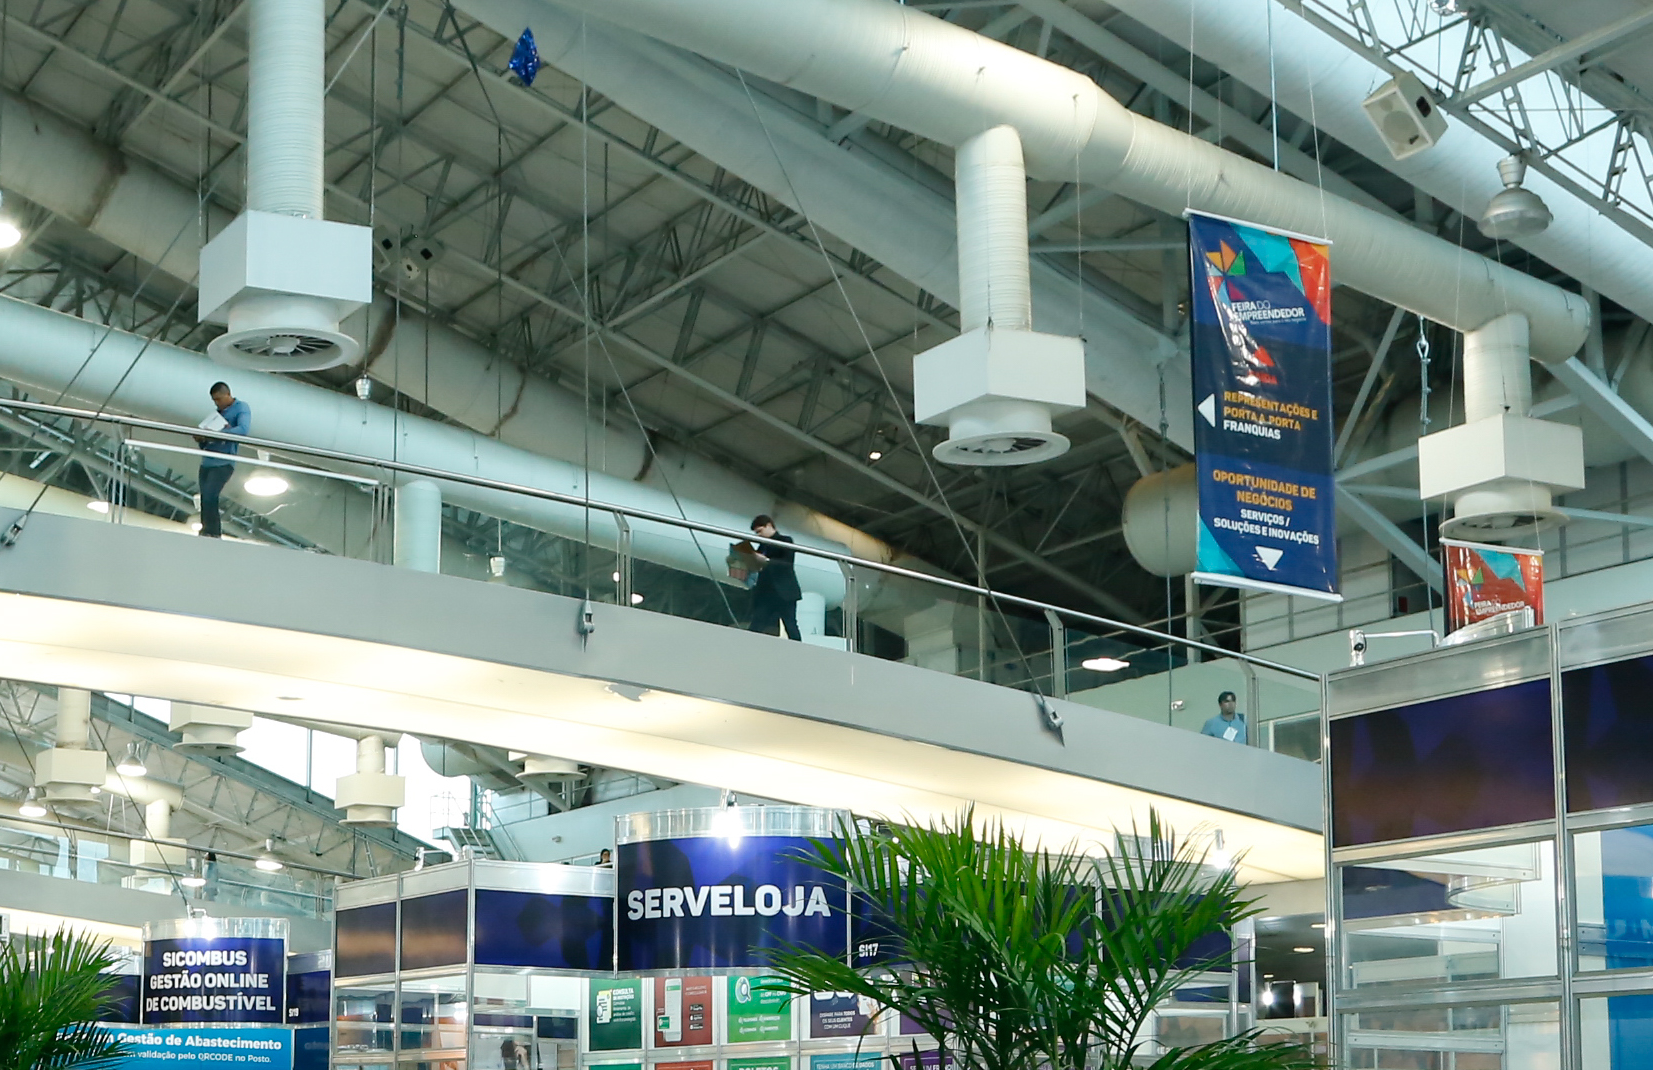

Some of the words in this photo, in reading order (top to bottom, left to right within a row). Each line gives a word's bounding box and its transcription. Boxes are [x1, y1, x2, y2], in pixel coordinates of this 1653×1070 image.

[1231, 301, 1256, 311] FEIRA
[1256, 300, 1271, 310] DO
[1232, 307, 1305, 322] EMPREENDEDOR
[1224, 391, 1310, 417] REPRESENTAÇÕES
[1311, 409, 1318, 420] E
[1223, 406, 1257, 421] PORTA
[1268, 415, 1302, 430] PORTA
[1223, 420, 1281, 440] FRANQUIAS
[1213, 469, 1299, 496] OPORTUNIDADE
[1300, 486, 1316, 499] DE
[1236, 490, 1293, 511] NEGÓCIOS
[1240, 508, 1284, 526] SERVIÇOS
[1285, 517, 1291, 526] /
[1213, 517, 1261, 535] SOLUÇÕES
[1262, 526, 1268, 536] E
[1268, 527, 1319, 545] INOVAÇÕES
[627, 884, 832, 921] SERVELOJA
[162, 950, 248, 968] SICOMBUS
[150, 970, 202, 990] GESTÃO
[204, 973, 269, 989] ONLINE
[146, 996, 159, 1012] DE
[160, 991, 276, 1012] COMBUSTÍVEL
[117, 1032, 162, 1046] Gestão
[165, 1034, 182, 1046] de
[185, 1034, 282, 1050] Abastecimento
[137, 1050, 176, 1061] validação
[177, 1051, 196, 1062] pelo
[198, 1052, 233, 1062] QRCODE
[248, 1053, 272, 1063] Posto.
